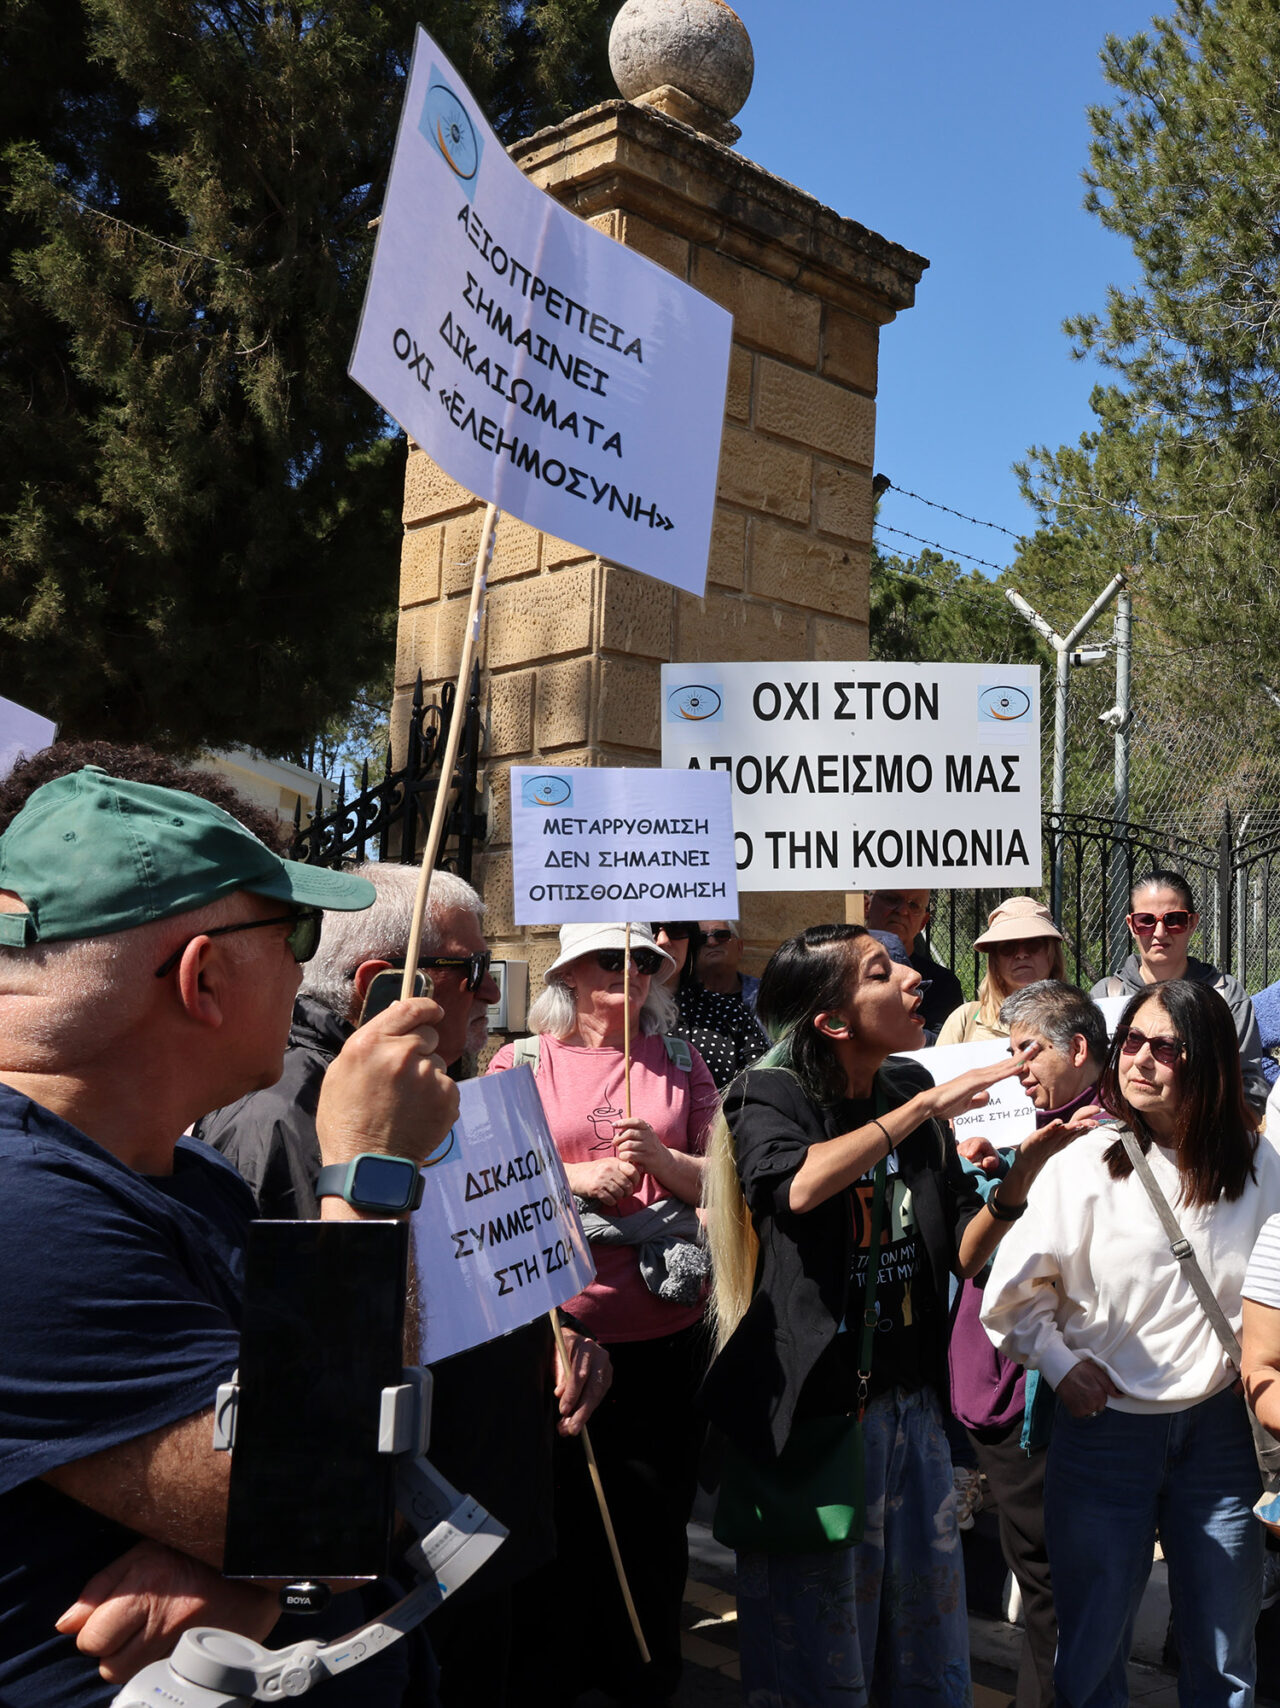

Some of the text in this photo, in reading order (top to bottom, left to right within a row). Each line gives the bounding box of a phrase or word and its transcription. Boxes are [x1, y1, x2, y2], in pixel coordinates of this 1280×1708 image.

[458, 204, 645, 363] ΑΞΙΟΠΡΕΠΕΙΑ
[463, 272, 610, 397] ΣΗΜΑΙΝΕΙ
[439, 312, 623, 458] ΔΙΚΑΙΩΜΑΤΑ
[394, 328, 675, 531] ΟΧΙ «ΕΛΕΗΜΟΣΥΝΗ»
[753, 682, 939, 722] ΟΧΙ ΣΤΟΝ
[947, 755, 1021, 793] ΜΑΣ
[543, 817, 709, 836] ΜΕΤΑΡΡΥΘΜΙΣΗ
[544, 849, 711, 869] ΔΕΝ ΣΗΜΑΙΝΕΙ
[764, 831, 839, 869] ΤΗΝ
[853, 829, 1030, 868] ΚΟΙΝΩΝΙΑ
[529, 880, 726, 902] ΟΠΙΣΘΟΔΡΟΜΗΣΗ
[954, 1114, 985, 1126] ΟΧΗΣ
[989, 1111, 1011, 1121] ΣΤΗ
[900, 1243, 916, 1261] MY
[494, 1257, 540, 1296] ΣΤΗ
[286, 1596, 312, 1605] BOYA
